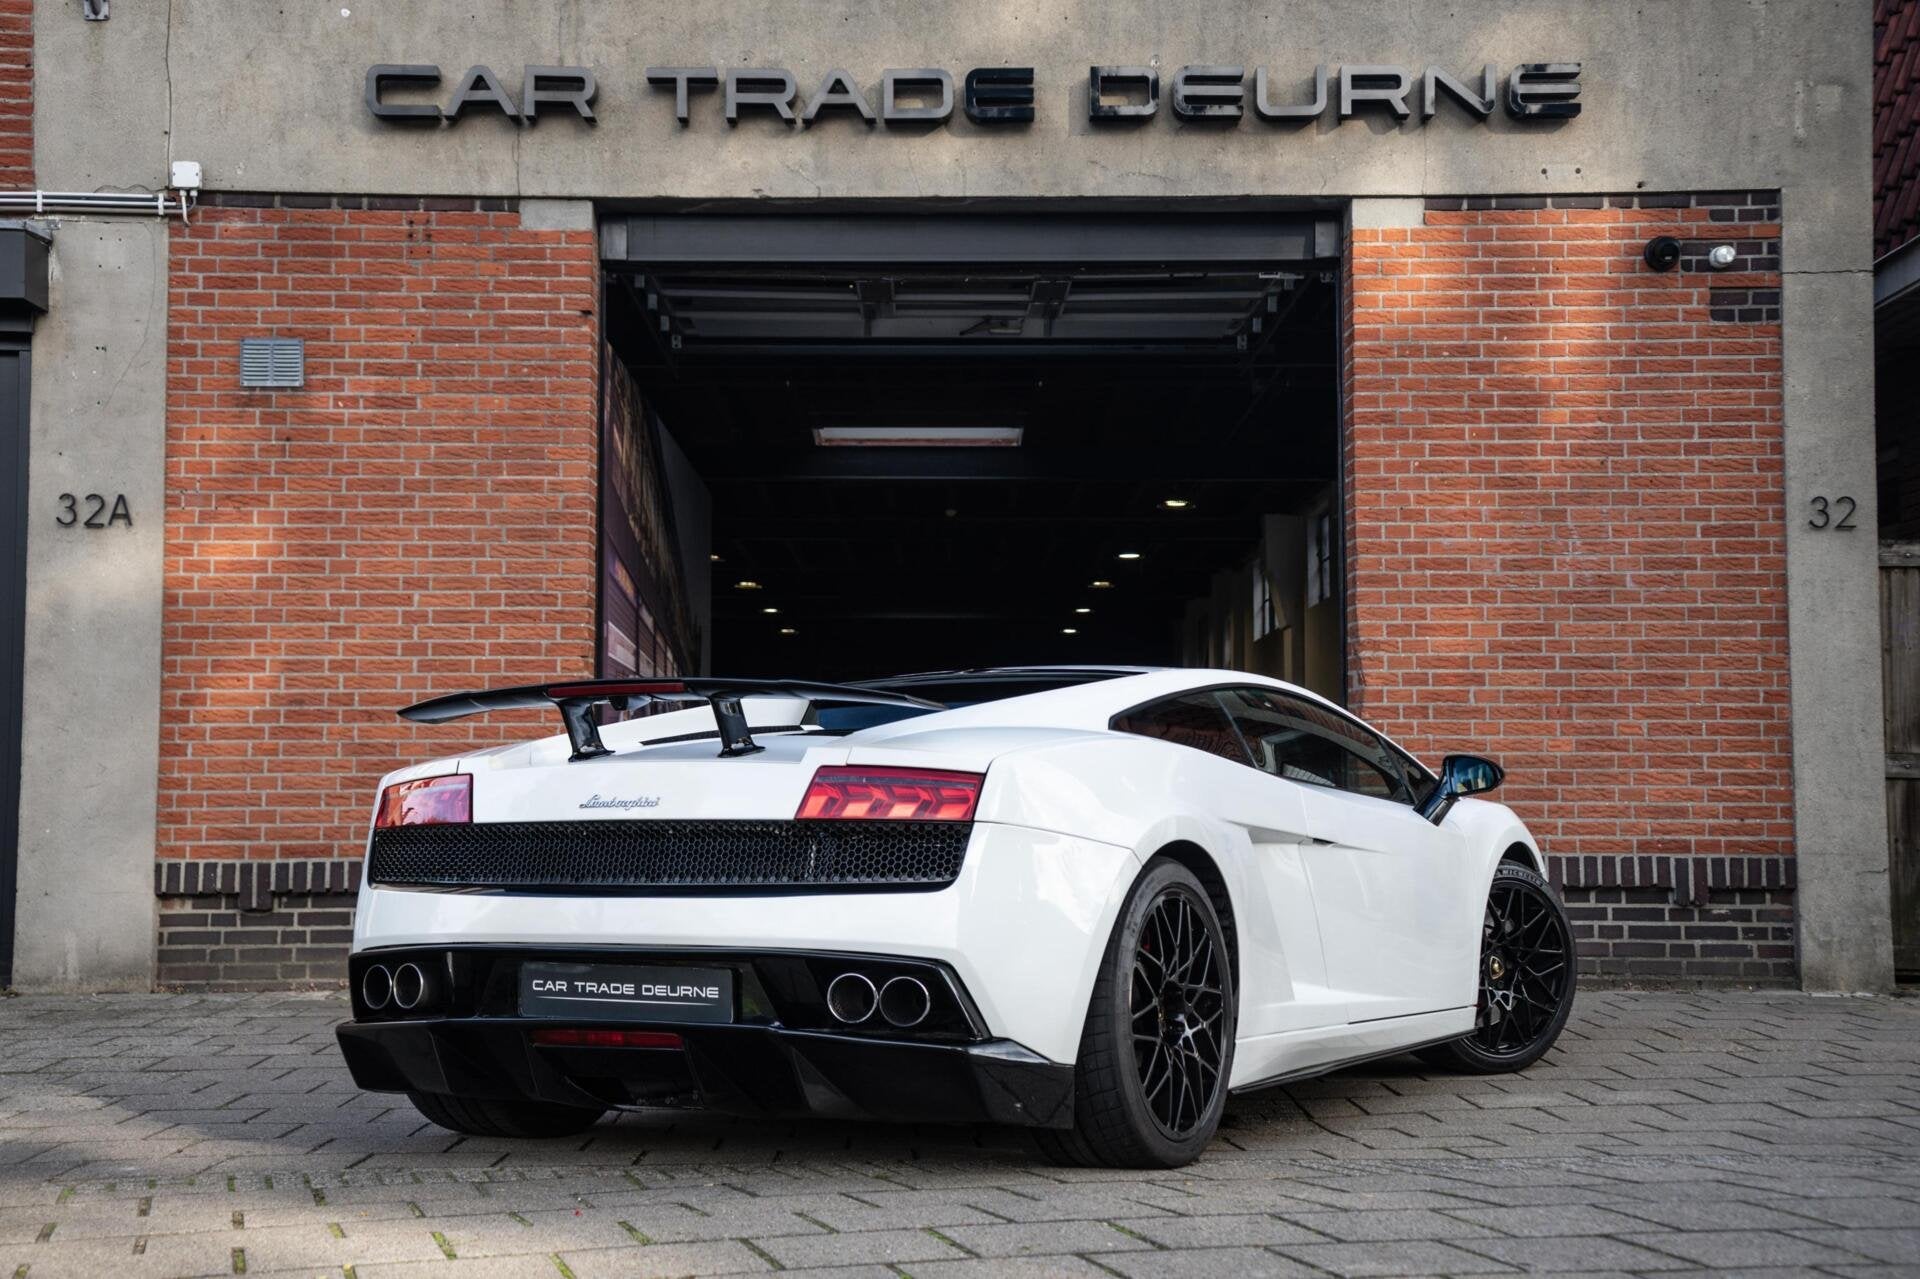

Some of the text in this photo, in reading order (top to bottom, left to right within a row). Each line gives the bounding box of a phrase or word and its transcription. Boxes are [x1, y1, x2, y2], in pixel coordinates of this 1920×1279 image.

[365, 63, 1582, 128] CAR TRADE DEURNE
[56, 493, 132, 528] 32A
[1808, 496, 1857, 531] 32
[532, 980, 719, 998] CAR TRADE DEURNE
